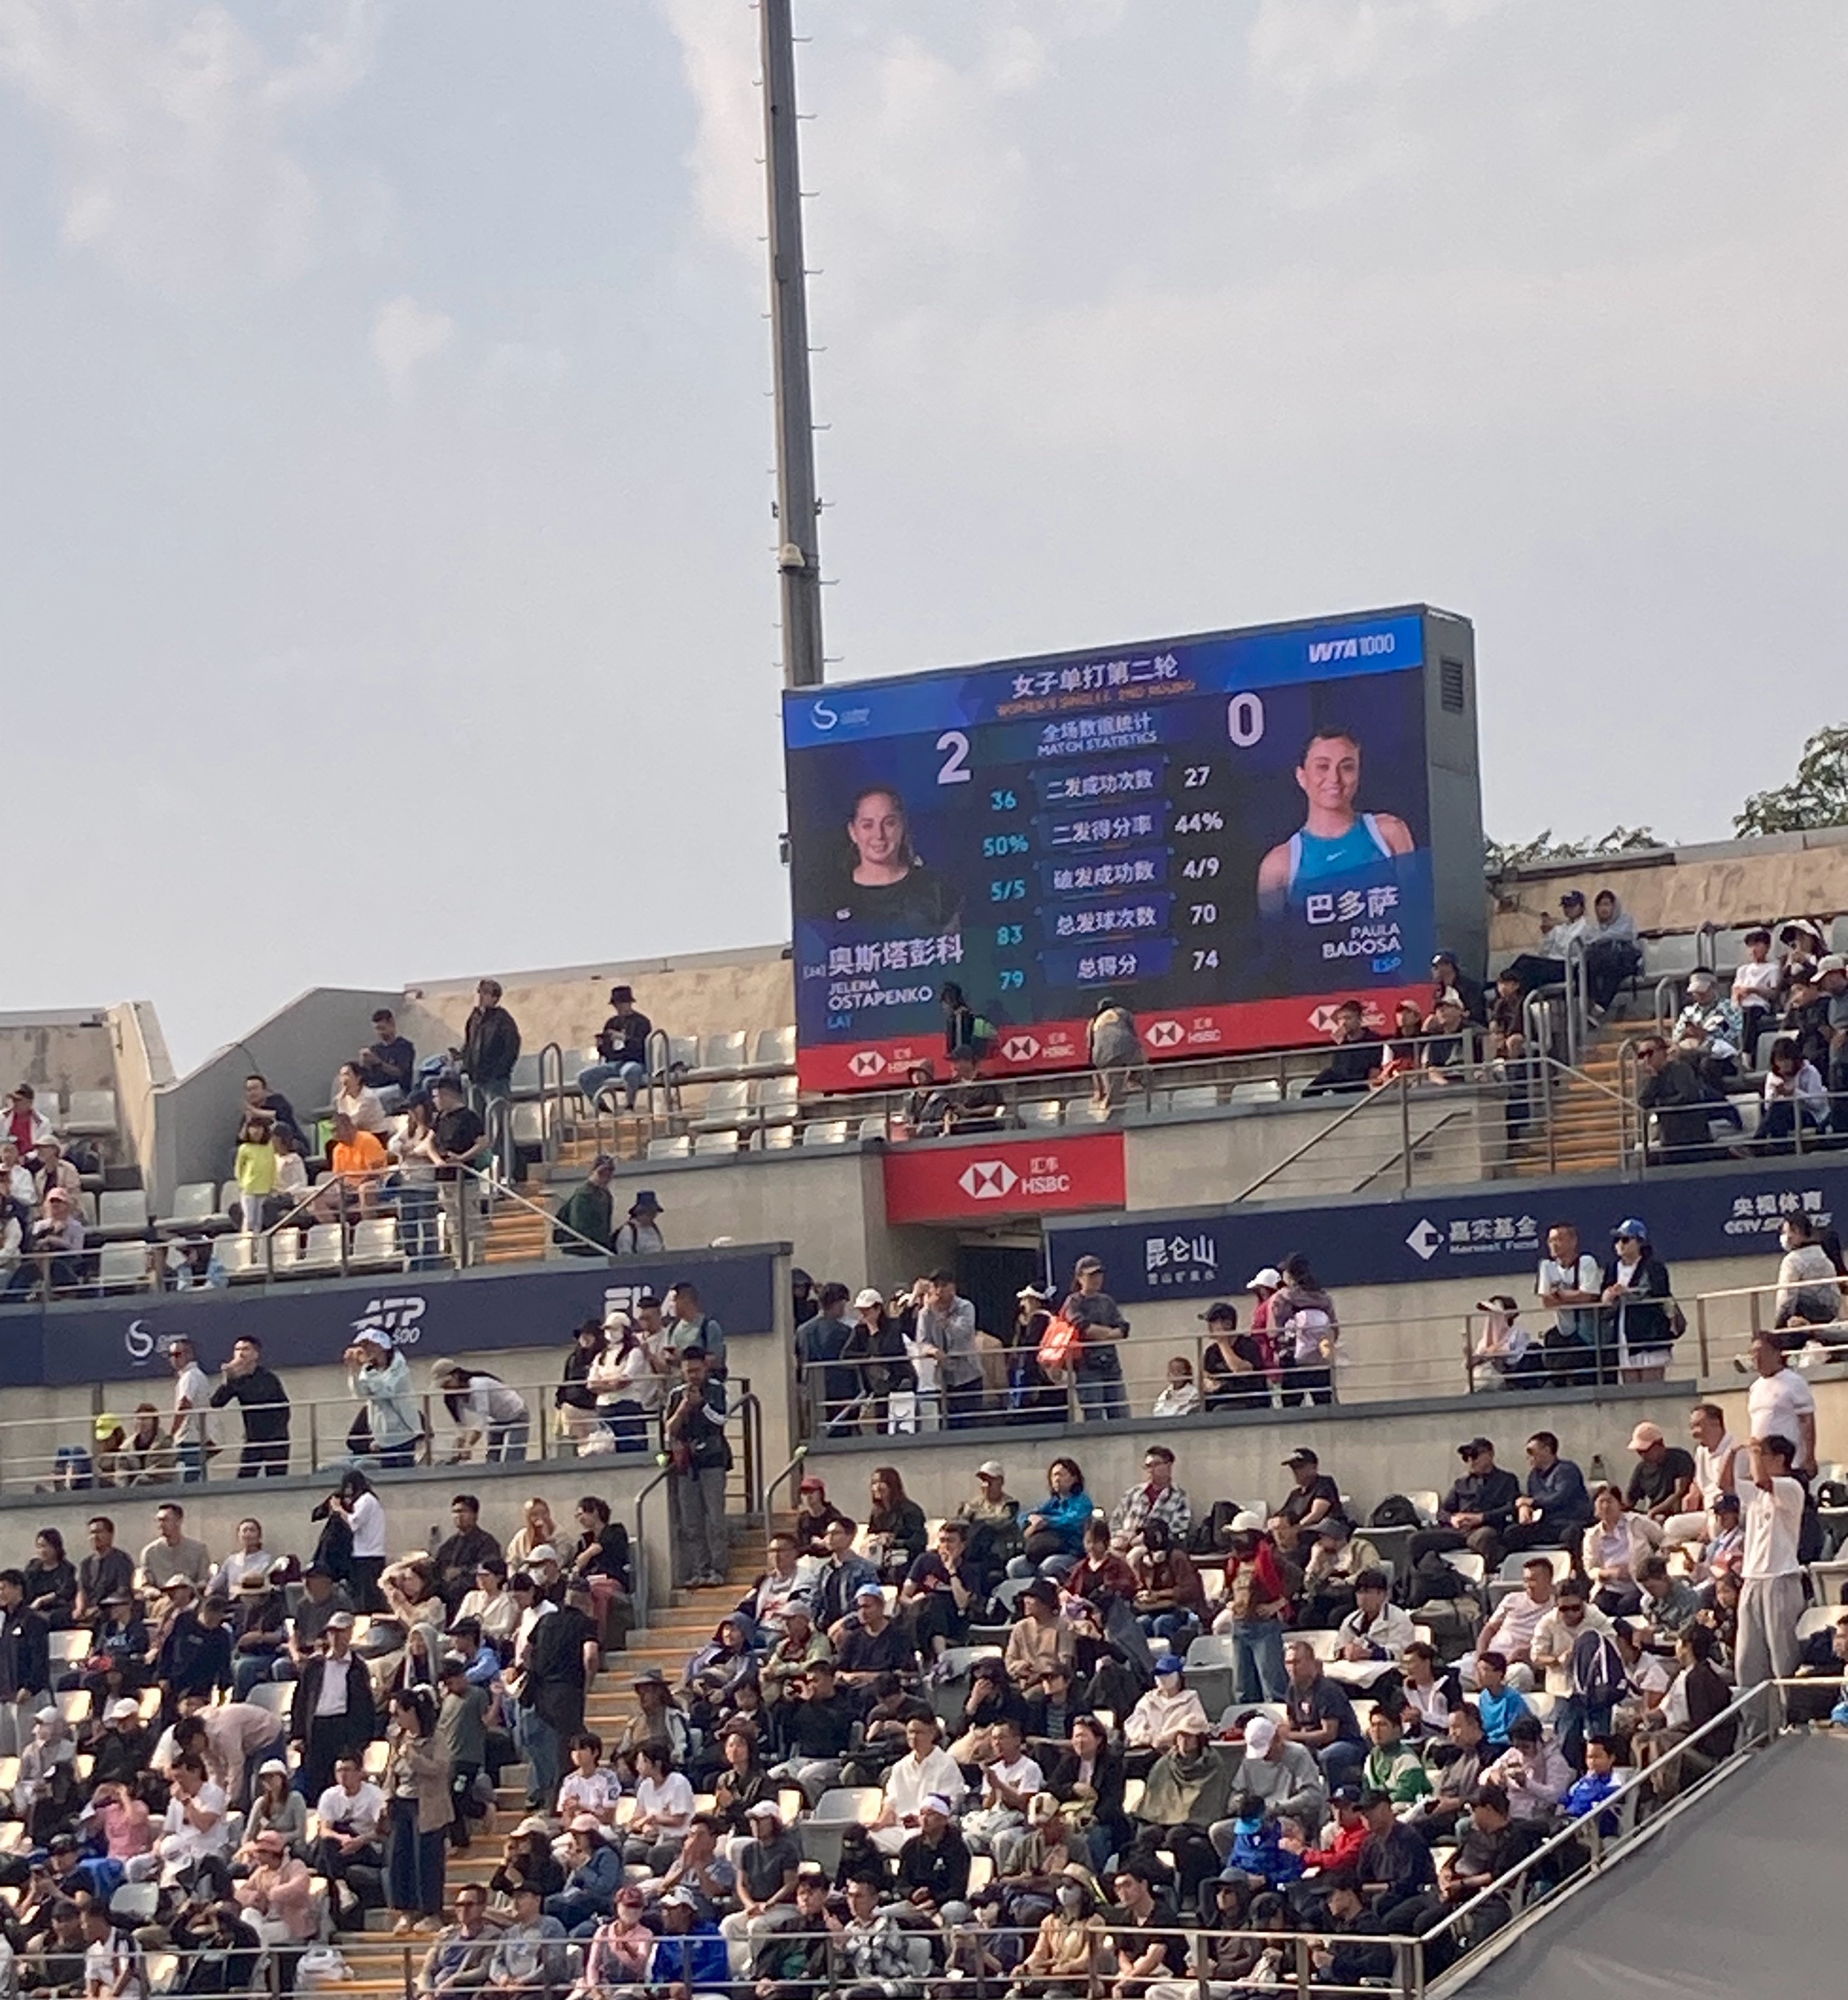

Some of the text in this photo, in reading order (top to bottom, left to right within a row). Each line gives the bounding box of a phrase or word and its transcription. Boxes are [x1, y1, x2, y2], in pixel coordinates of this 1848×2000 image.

[1309, 632, 1395, 663] WTA 1000
[1012, 653, 1179, 699] 女子单打第二轮
[1228, 692, 1265, 748] 0
[936, 731, 972, 785] 2
[1037, 741, 1084, 756] MATCH
[1046, 769, 1154, 800] 二发成功次数
[1184, 766, 1211, 788] 27
[991, 791, 1017, 810] 36
[1052, 815, 1153, 845] 二发得分率
[1174, 811, 1223, 833] 44%
[983, 835, 1029, 857] 50%
[1053, 860, 1155, 890] 破发成功数
[1182, 857, 1220, 879] 4/9
[991, 880, 1026, 901] 5/5
[1189, 904, 1217, 925] 70
[1307, 885, 1399, 925] 巴多萨
[1055, 906, 1157, 936] 总发球次数
[1351, 923, 1401, 939] PAULA
[997, 925, 1024, 945] 83
[828, 934, 964, 976] 奥斯塔彭科
[1322, 936, 1402, 959] BADOSA
[1077, 953, 1138, 979] 总得分
[1192, 950, 1219, 971] 74
[829, 978, 879, 996] JELENA
[1000, 972, 1025, 991] 79
[829, 985, 933, 1011] OSTAPENKO
[1021, 1174, 1071, 1195] HSBC
[1733, 1190, 1822, 1217] 央视体育
[1146, 1235, 1219, 1271] 昆仑山
[350, 1297, 426, 1330] ATP
